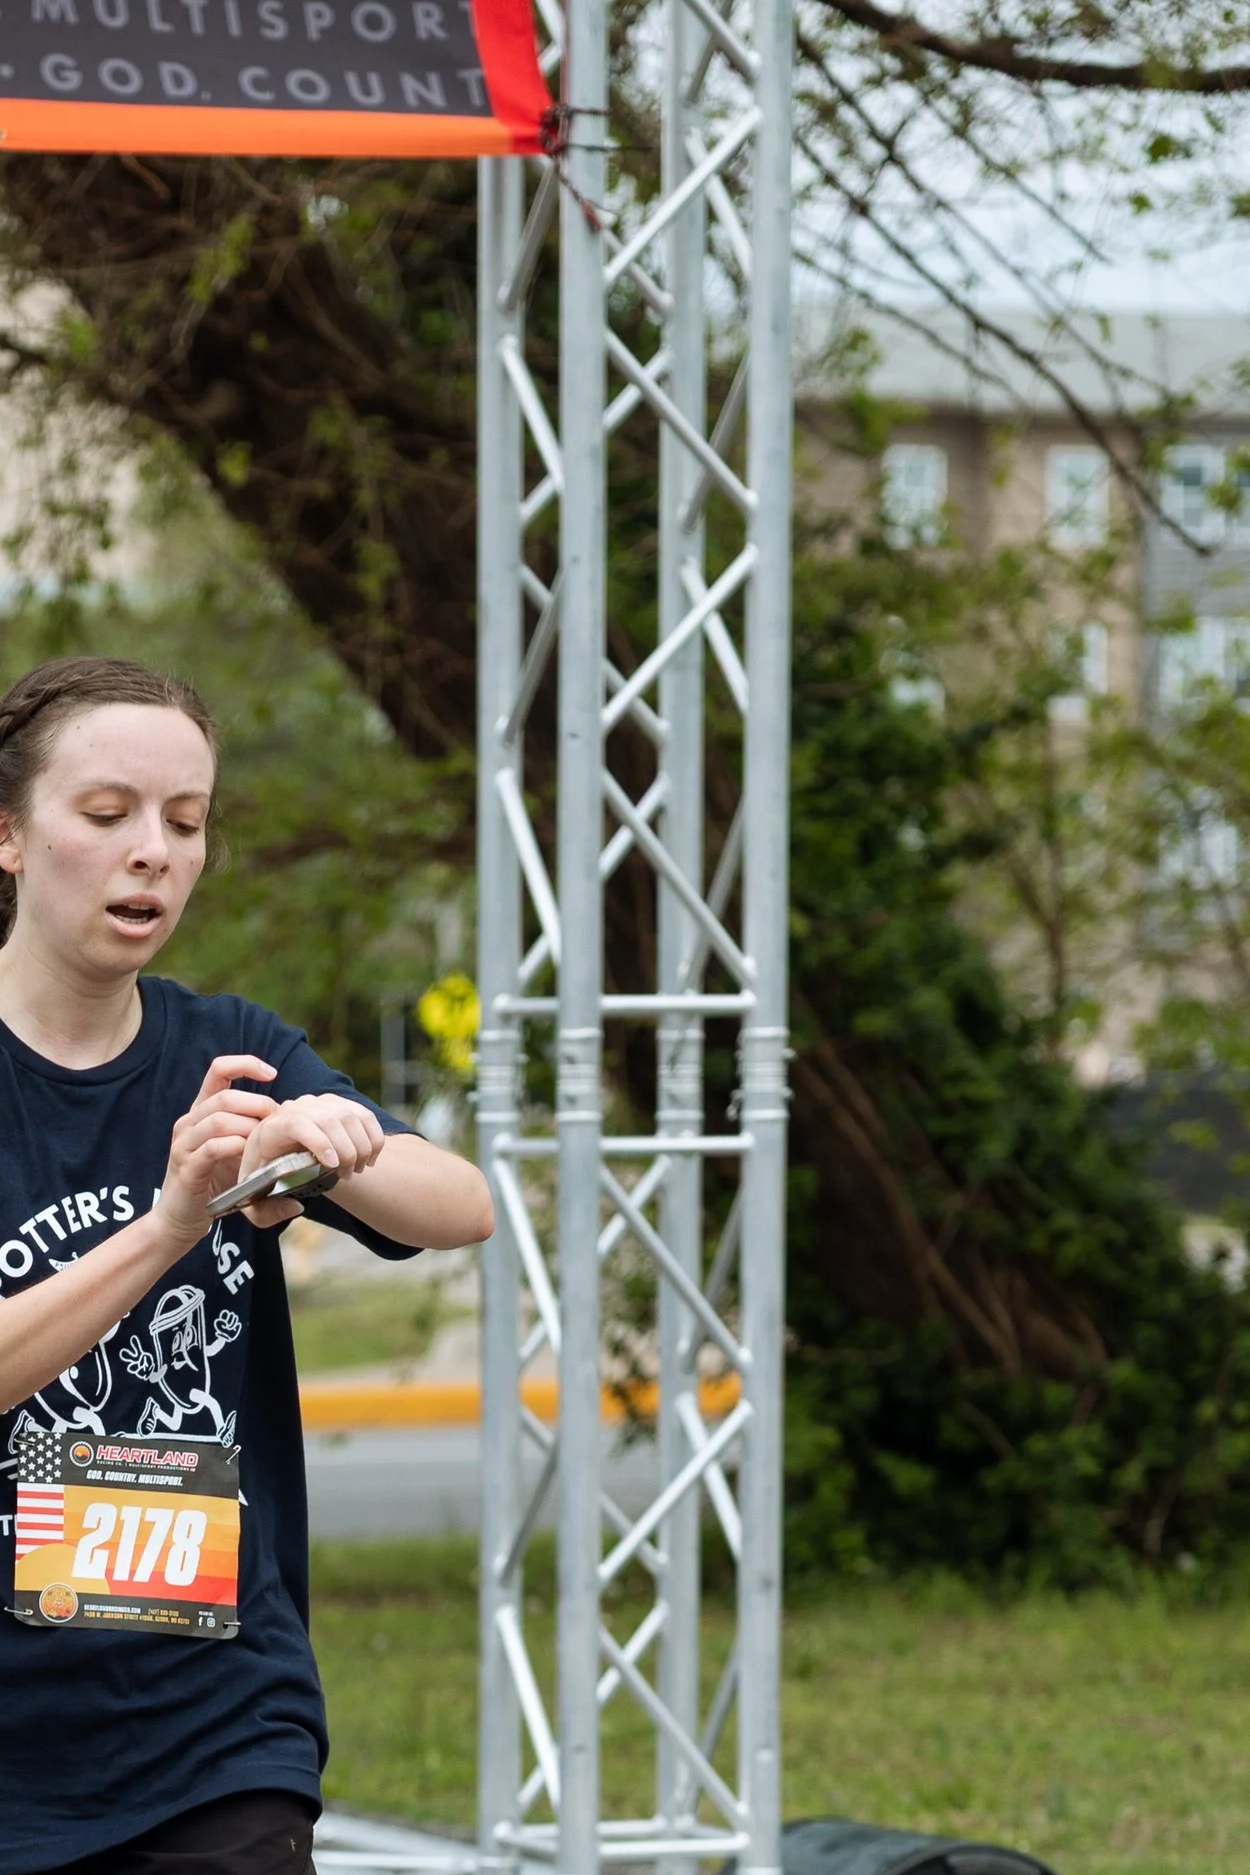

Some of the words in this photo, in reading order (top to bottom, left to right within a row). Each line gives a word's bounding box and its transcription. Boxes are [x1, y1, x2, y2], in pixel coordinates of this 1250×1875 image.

[95, 1444, 199, 1468] HEARTLAND
[86, 1469, 104, 1480] GOD.
[104, 1470, 137, 1483] COUNTRY.
[138, 1474, 184, 1487] MULTISPORT.
[71, 1502, 208, 1587] 2178
